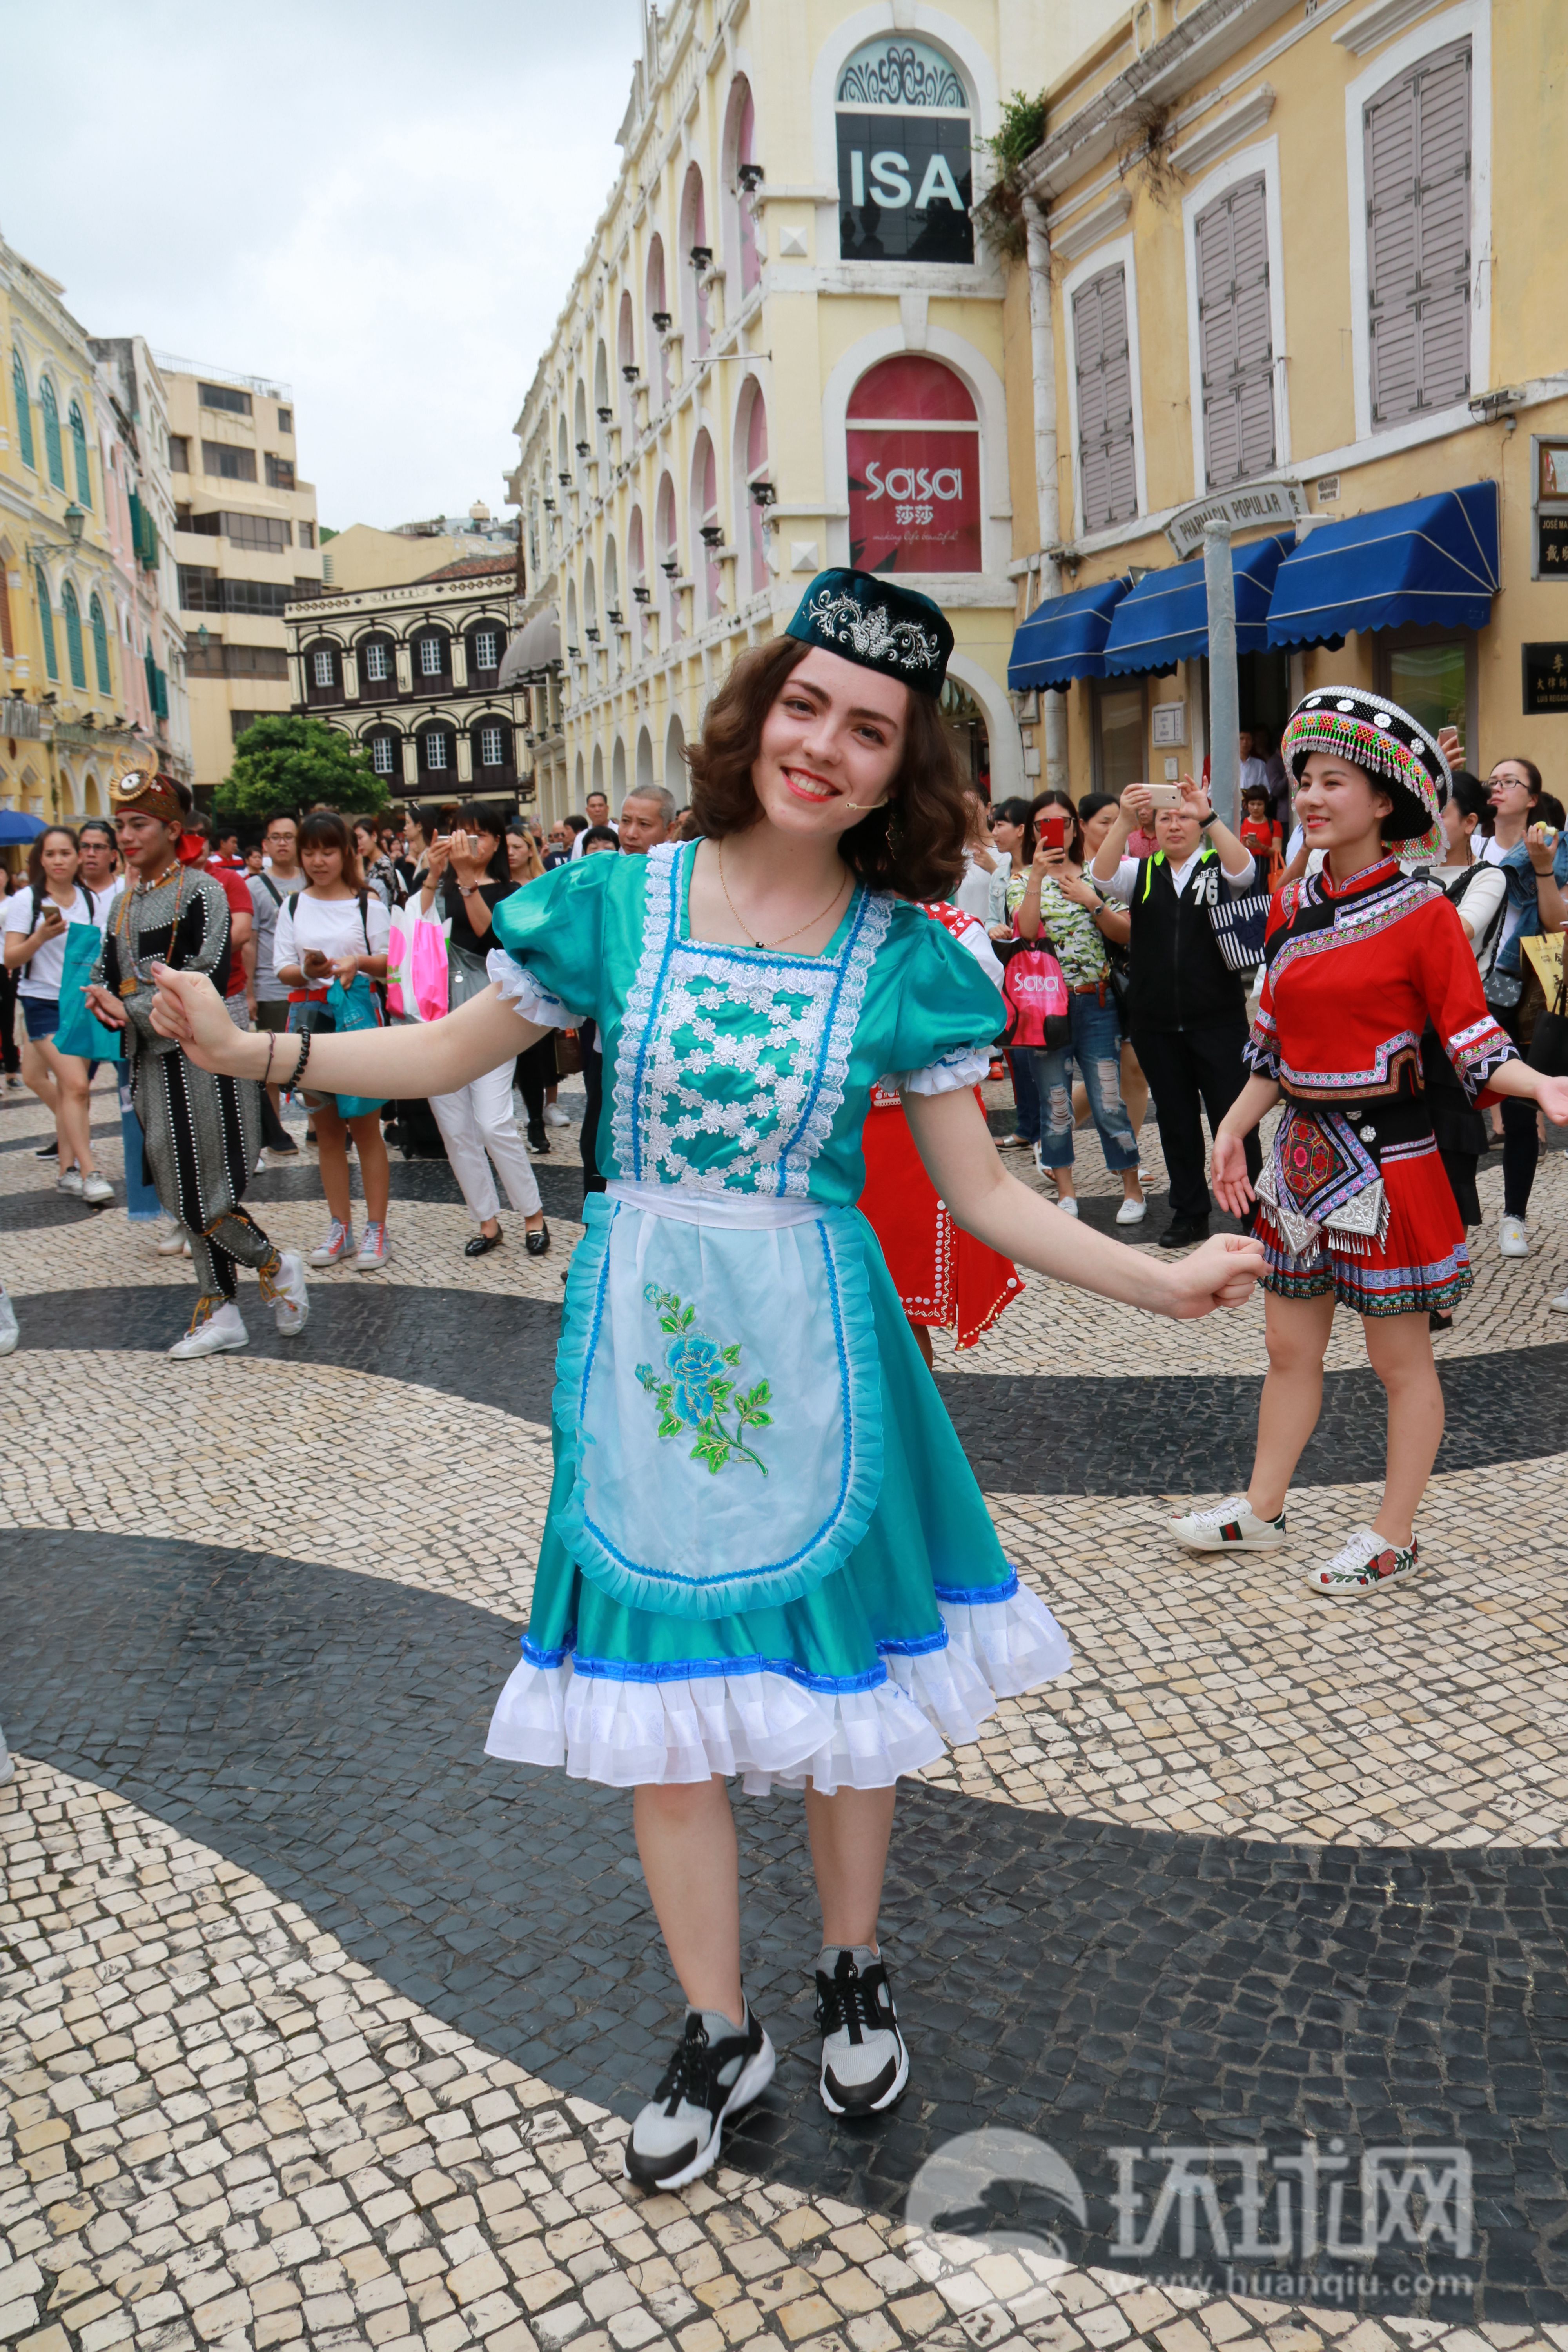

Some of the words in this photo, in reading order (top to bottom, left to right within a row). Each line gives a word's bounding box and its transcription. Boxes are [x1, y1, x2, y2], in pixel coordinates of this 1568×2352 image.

[850, 150, 965, 211] ISA
[895, 505, 934, 525] 莎莎
[1231, 493, 1282, 520] POPULAR
[1543, 518, 1558, 529] JOSÉ
[1559, 520, 1568, 529] MA
[873, 531, 902, 545] making
[904, 530, 919, 545] life
[922, 530, 958, 545] beautiful
[1192, 878, 1218, 906] 76
